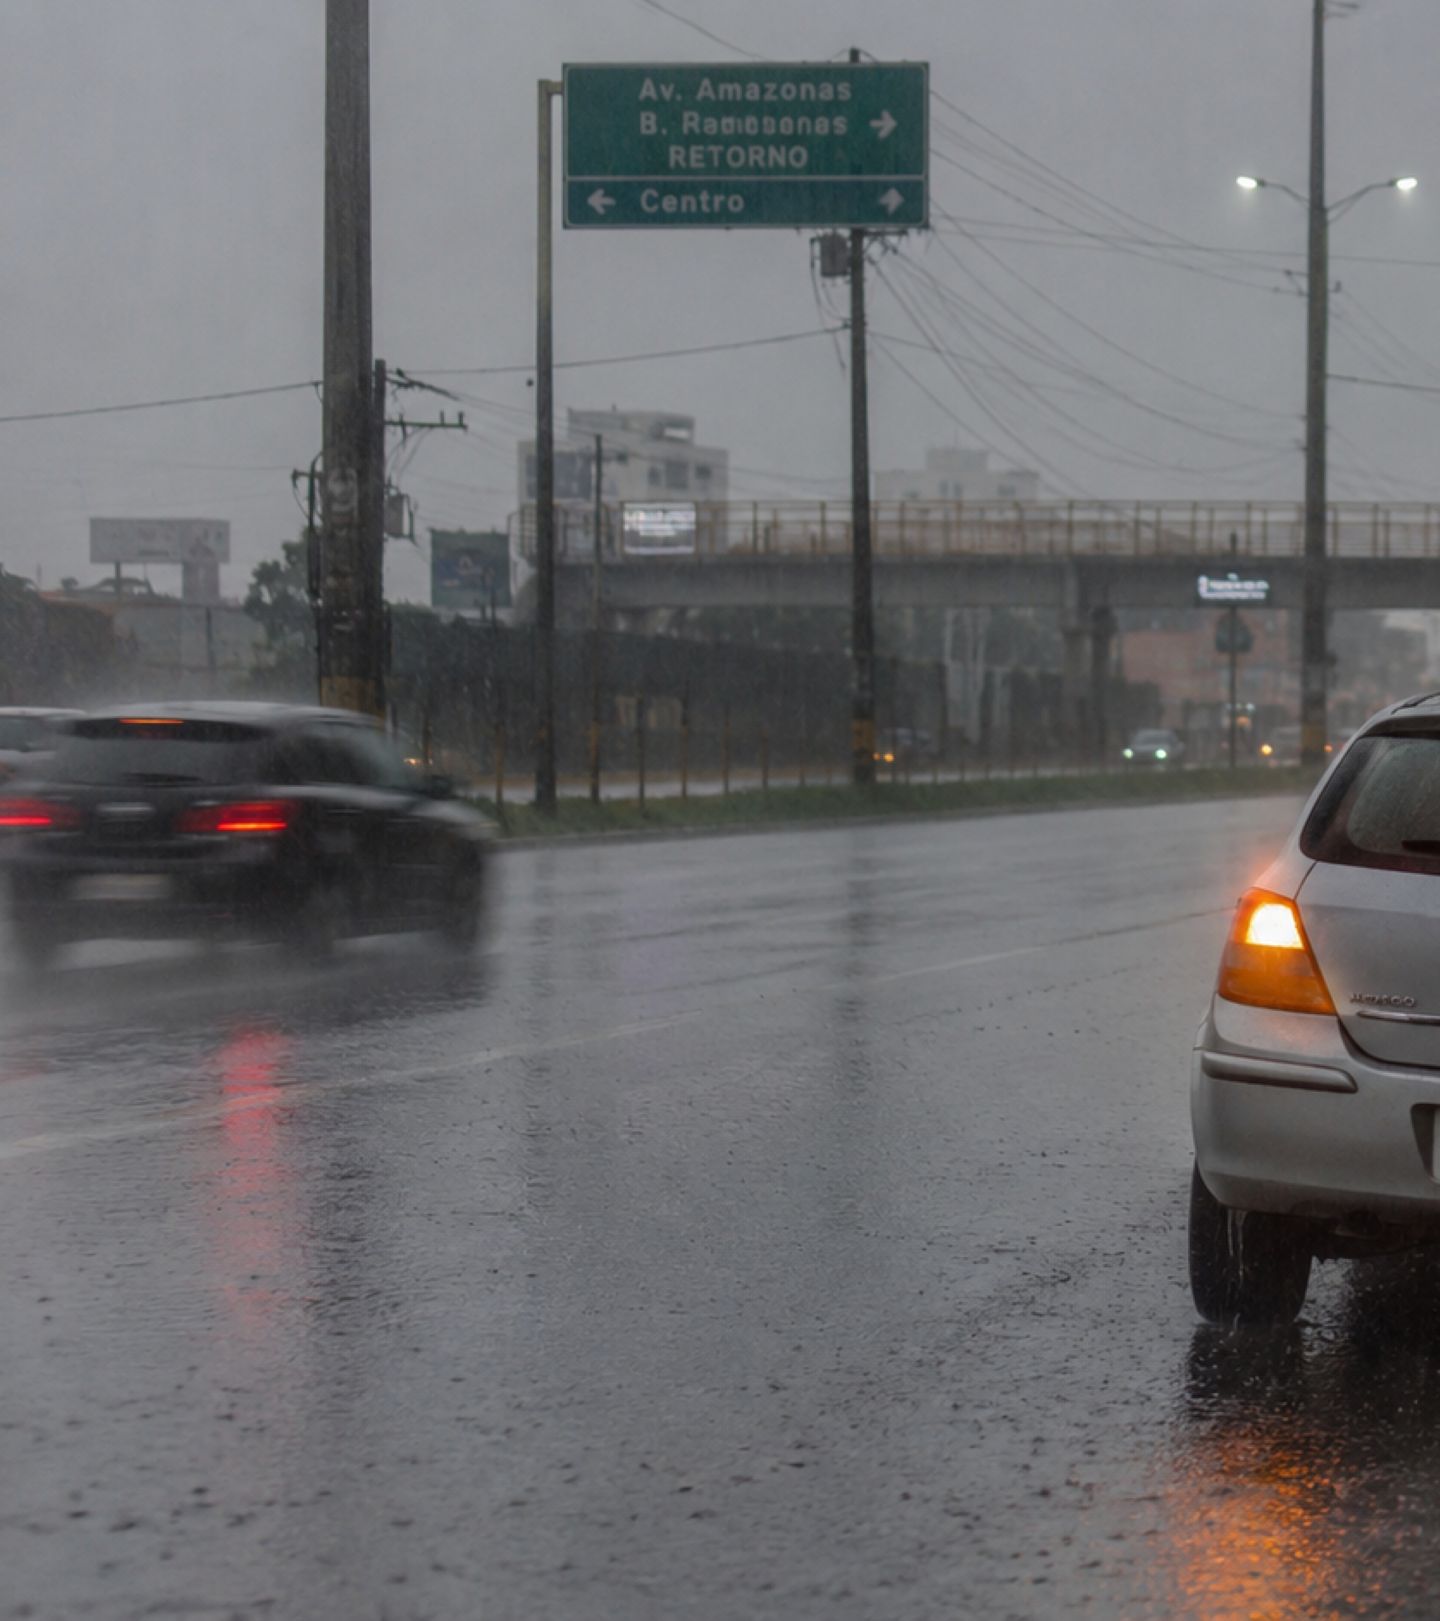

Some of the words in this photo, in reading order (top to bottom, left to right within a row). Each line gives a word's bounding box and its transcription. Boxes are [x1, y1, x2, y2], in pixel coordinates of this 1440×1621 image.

[639, 78, 682, 101] Av.
[697, 78, 851, 101] Amazonas
[639, 111, 667, 135] B.
[669, 145, 808, 168] RETORNO
[640, 189, 744, 212] Centro
